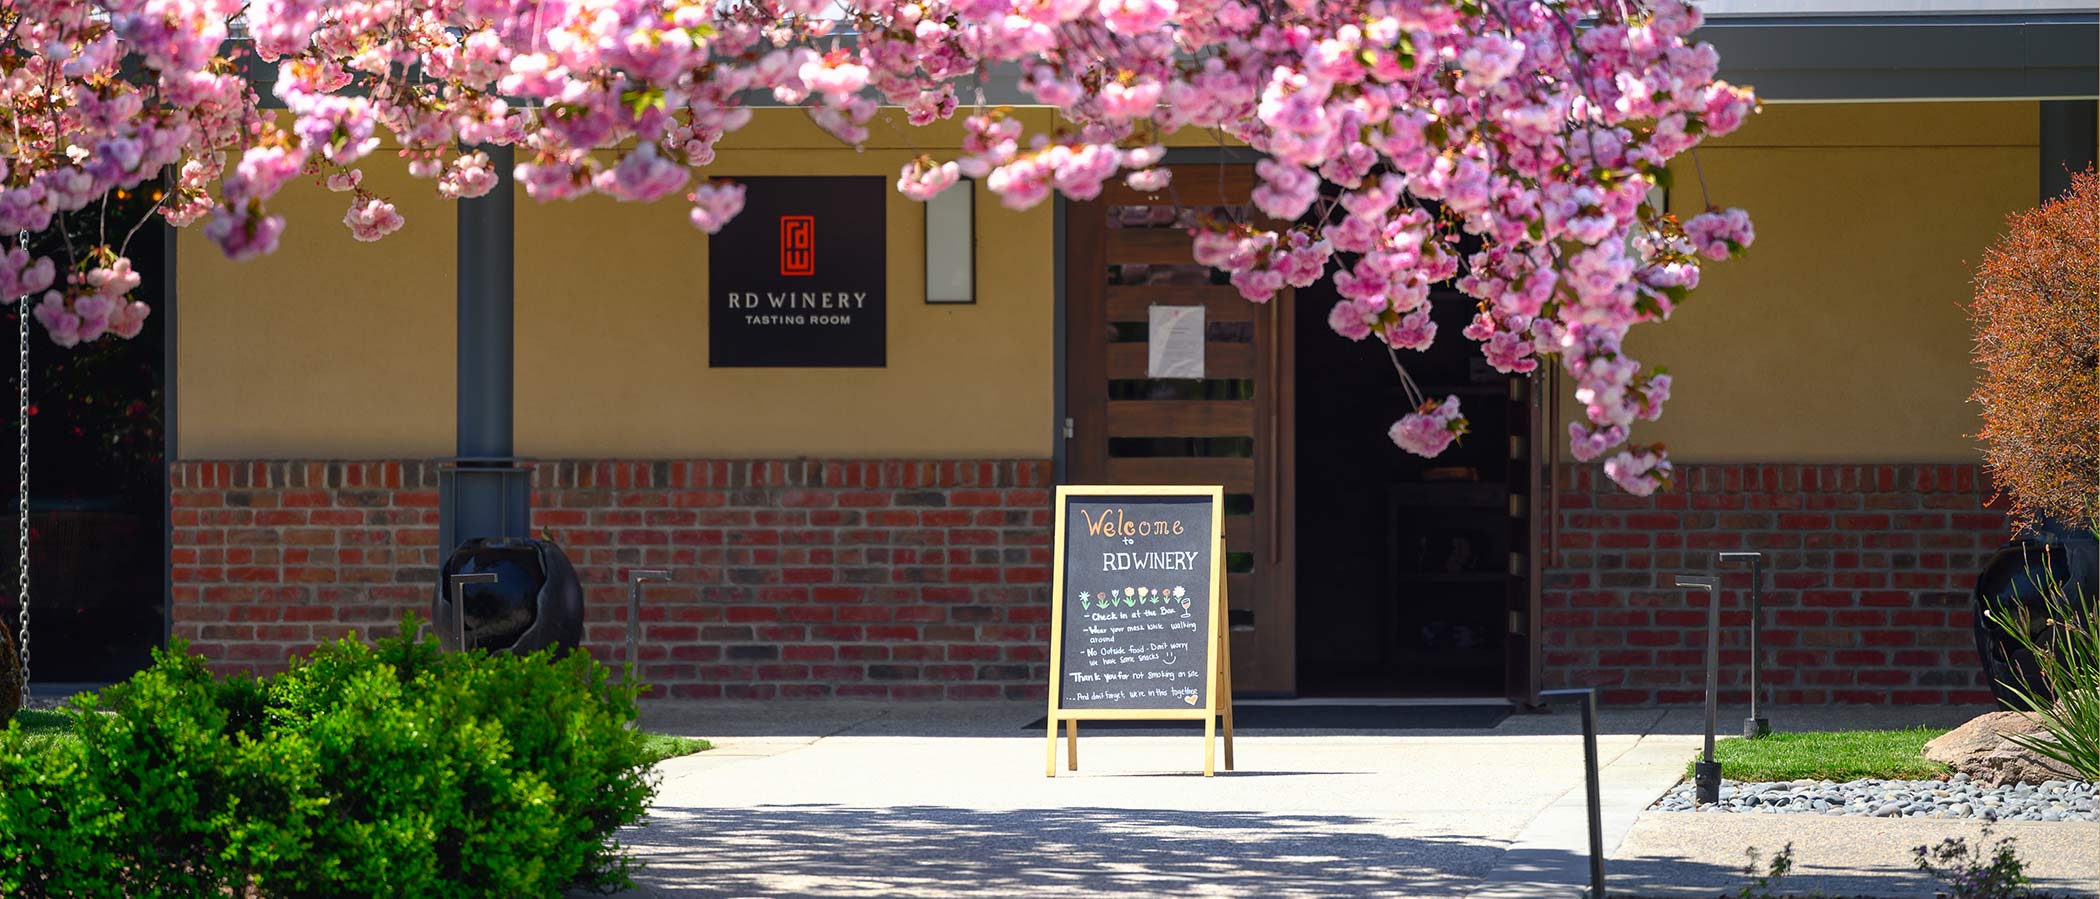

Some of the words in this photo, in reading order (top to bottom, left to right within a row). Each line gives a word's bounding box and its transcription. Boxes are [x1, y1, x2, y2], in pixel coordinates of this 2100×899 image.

[728, 292, 759, 309] RD
[767, 292, 866, 309] WINERY
[745, 315, 805, 325] TASTING
[810, 315, 850, 325] ROOM
[1080, 508, 1184, 537] Welcome
[1122, 536, 1135, 546] to
[1091, 612, 1118, 621] Check
[1131, 609, 1141, 618] at
[1143, 609, 1157, 617] the
[1170, 621, 1197, 632] walking
[1086, 647, 1098, 657] No
[1128, 644, 1144, 654] food
[1170, 642, 1188, 651] worry
[1068, 671, 1101, 683] Thank
[1103, 673, 1117, 683] you
[1117, 670, 1130, 680] for
[1132, 671, 1144, 680] not
[1155, 687, 1168, 697] this
